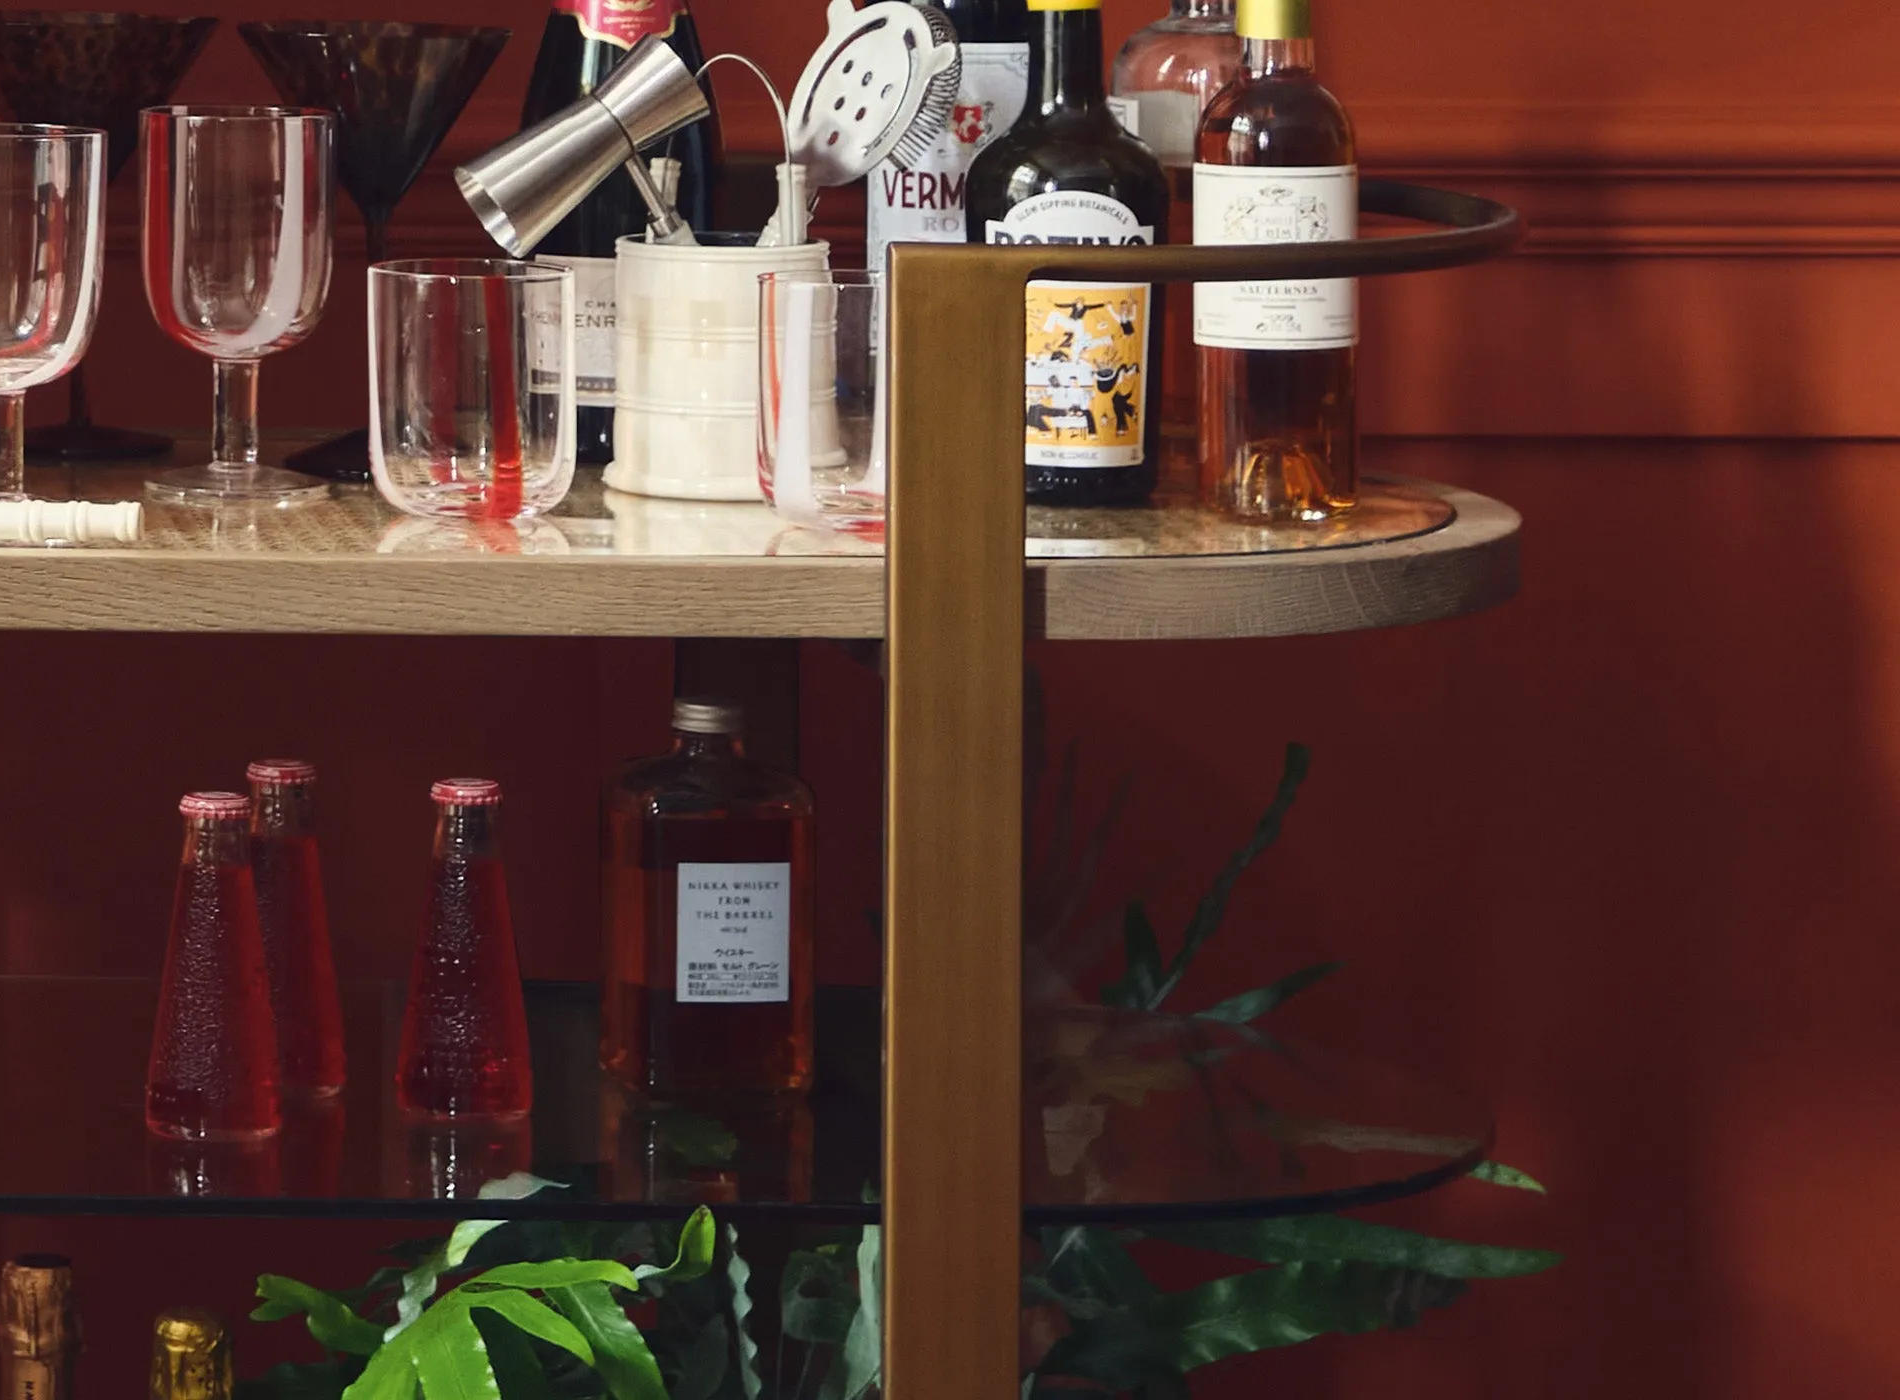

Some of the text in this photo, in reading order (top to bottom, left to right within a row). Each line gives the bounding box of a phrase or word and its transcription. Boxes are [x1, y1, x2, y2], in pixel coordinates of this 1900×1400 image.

[882, 169, 965, 210] VERM
[1015, 199, 1129, 225] SLOW SIPPING BOTANICALS
[1239, 285, 1318, 294] SAUTERNES
[688, 882, 779, 890] NIKKA WHISKY
[718, 896, 751, 905] FROM
[696, 911, 773, 920] THE BARREL
